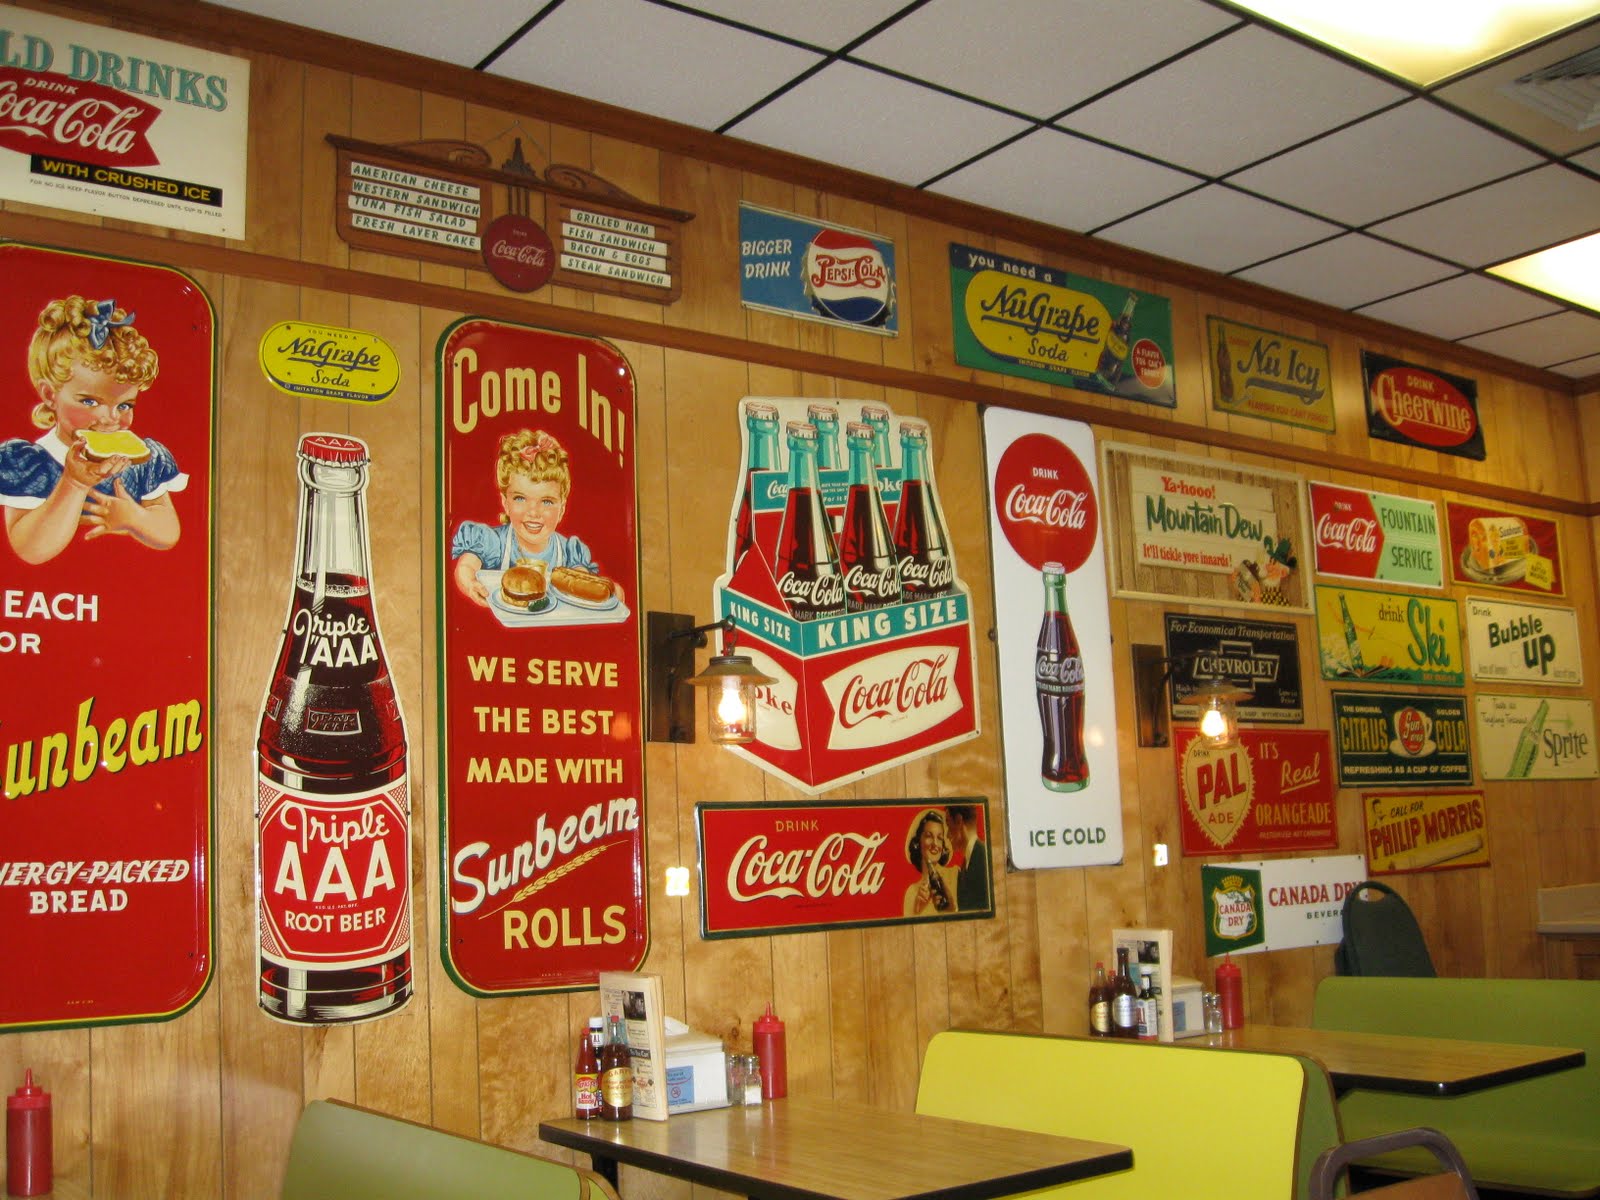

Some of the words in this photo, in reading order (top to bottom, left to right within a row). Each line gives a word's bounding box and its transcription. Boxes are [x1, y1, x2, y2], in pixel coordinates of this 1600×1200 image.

[24, 77, 79, 95] DRINK
[68, 43, 228, 112] DRINKS
[42, 159, 89, 178] WITH
[94, 169, 179, 195] CRUSHED
[183, 185, 211, 201] ICE
[353, 165, 417, 186] AMERICAN
[424, 179, 469, 196] CHEESE
[108, 192, 130, 200] BUTTON
[132, 196, 165, 207] DEPRESSED
[353, 181, 409, 201] WESTERN
[416, 195, 480, 216] SANDWICH
[355, 196, 386, 211] TUNA
[394, 204, 422, 219] FISH
[429, 212, 466, 228] SALAD
[355, 215, 395, 231] FRESH
[403, 224, 439, 240] LAYER
[445, 233, 476, 247] CAKE
[576, 212, 620, 228] GRILLED
[626, 222, 649, 235] HAM
[491, 239, 546, 267] Coca-Cola
[569, 227, 593, 240] FISH
[600, 233, 656, 253] SANDWICH
[570, 242, 606, 257] BACON
[612, 251, 618, 259] &
[625, 253, 652, 266] EGGS
[741, 239, 792, 256] BIGGER
[568, 258, 602, 273] STEAK
[608, 266, 664, 285] SANDWICH
[744, 261, 791, 279] DRINK
[968, 253, 995, 268] you
[1003, 262, 1036, 280] need
[1044, 273, 1052, 283] a
[980, 285, 1100, 344] NuGrape
[277, 337, 381, 372] NuGrape
[1028, 337, 1070, 363] Soda
[1237, 336, 1281, 377] Nu
[293, 385, 324, 395] IMITATION
[311, 368, 351, 388] Soda
[1407, 375, 1435, 392] DRINK
[453, 347, 561, 434] Come
[578, 353, 626, 469] In!
[1376, 374, 1471, 433] Cheerwine
[877, 477, 903, 492] oke
[1032, 467, 1059, 480] DRINK
[1161, 476, 1216, 500] Ya-hooo!
[1005, 483, 1088, 530] Coca-Cola
[1146, 495, 1223, 537] Mountain
[1218, 502, 1263, 542] Dew
[1316, 513, 1377, 553] Coca-Cola
[1381, 507, 1436, 535] FOUNTAIN
[1160, 546, 1182, 562] tickle
[1391, 546, 1433, 571] SERVICE
[777, 570, 844, 605] Coca-Cola
[729, 601, 760, 627] KING
[763, 616, 792, 642] SIZE
[818, 616, 892, 650] KING
[904, 598, 958, 630] SIZE
[1472, 606, 1492, 618] Drink
[292, 608, 370, 664] Triple
[1170, 620, 1187, 633] For
[1188, 621, 1236, 636] Economical
[1237, 626, 1295, 641] Transportation
[1379, 603, 1405, 623] drink
[1407, 597, 1450, 667] Ski
[1488, 614, 1543, 648] Bubble
[467, 655, 516, 683] WE
[527, 658, 618, 687] SERVE
[1200, 656, 1274, 676] CHEVROLET
[753, 686, 793, 716] oke
[839, 651, 950, 729] Coca-Cola
[473, 706, 530, 734] THE
[542, 708, 614, 735] BEST
[1340, 716, 1389, 752] CITRUS
[1435, 720, 1467, 752] COLA
[0, 696, 203, 800] unbeam
[1193, 750, 1210, 758] DRINK
[1259, 741, 1279, 760] IT'S
[1543, 728, 1589, 767] Sprite
[466, 757, 548, 783] MADE
[555, 758, 624, 784] WITH
[1197, 752, 1247, 811] PAL
[1280, 751, 1321, 788] Real
[1343, 765, 1393, 775] REFRESHING
[1394, 765, 1405, 774] AS
[1407, 765, 1413, 774] A
[1413, 765, 1428, 774] CUP
[1430, 765, 1439, 773] OF
[1440, 765, 1467, 773] COFFEE
[1208, 812, 1234, 825] ADE
[1255, 803, 1331, 826] ORANGEADE
[1391, 805, 1408, 818] CALL
[1410, 801, 1424, 813] FOR
[280, 805, 390, 854] Triple
[775, 819, 819, 833] DRINK
[1029, 828, 1056, 847] ICE
[1062, 827, 1106, 846] COLD
[1369, 817, 1421, 860] PHILIP
[1422, 799, 1484, 844] MORRIS
[451, 797, 640, 914] Sunbeam
[727, 831, 890, 903] Coca-Cola
[274, 838, 396, 903] AAA
[29, 889, 129, 915] BREAD
[1219, 903, 1251, 915] CANADA
[1268, 884, 1330, 907] CANADA
[285, 909, 334, 933] ROOT
[340, 906, 386, 933] BEER
[503, 905, 626, 950] ROLLS
[1228, 915, 1245, 927] DRY
[1306, 909, 1344, 920] BEVER
